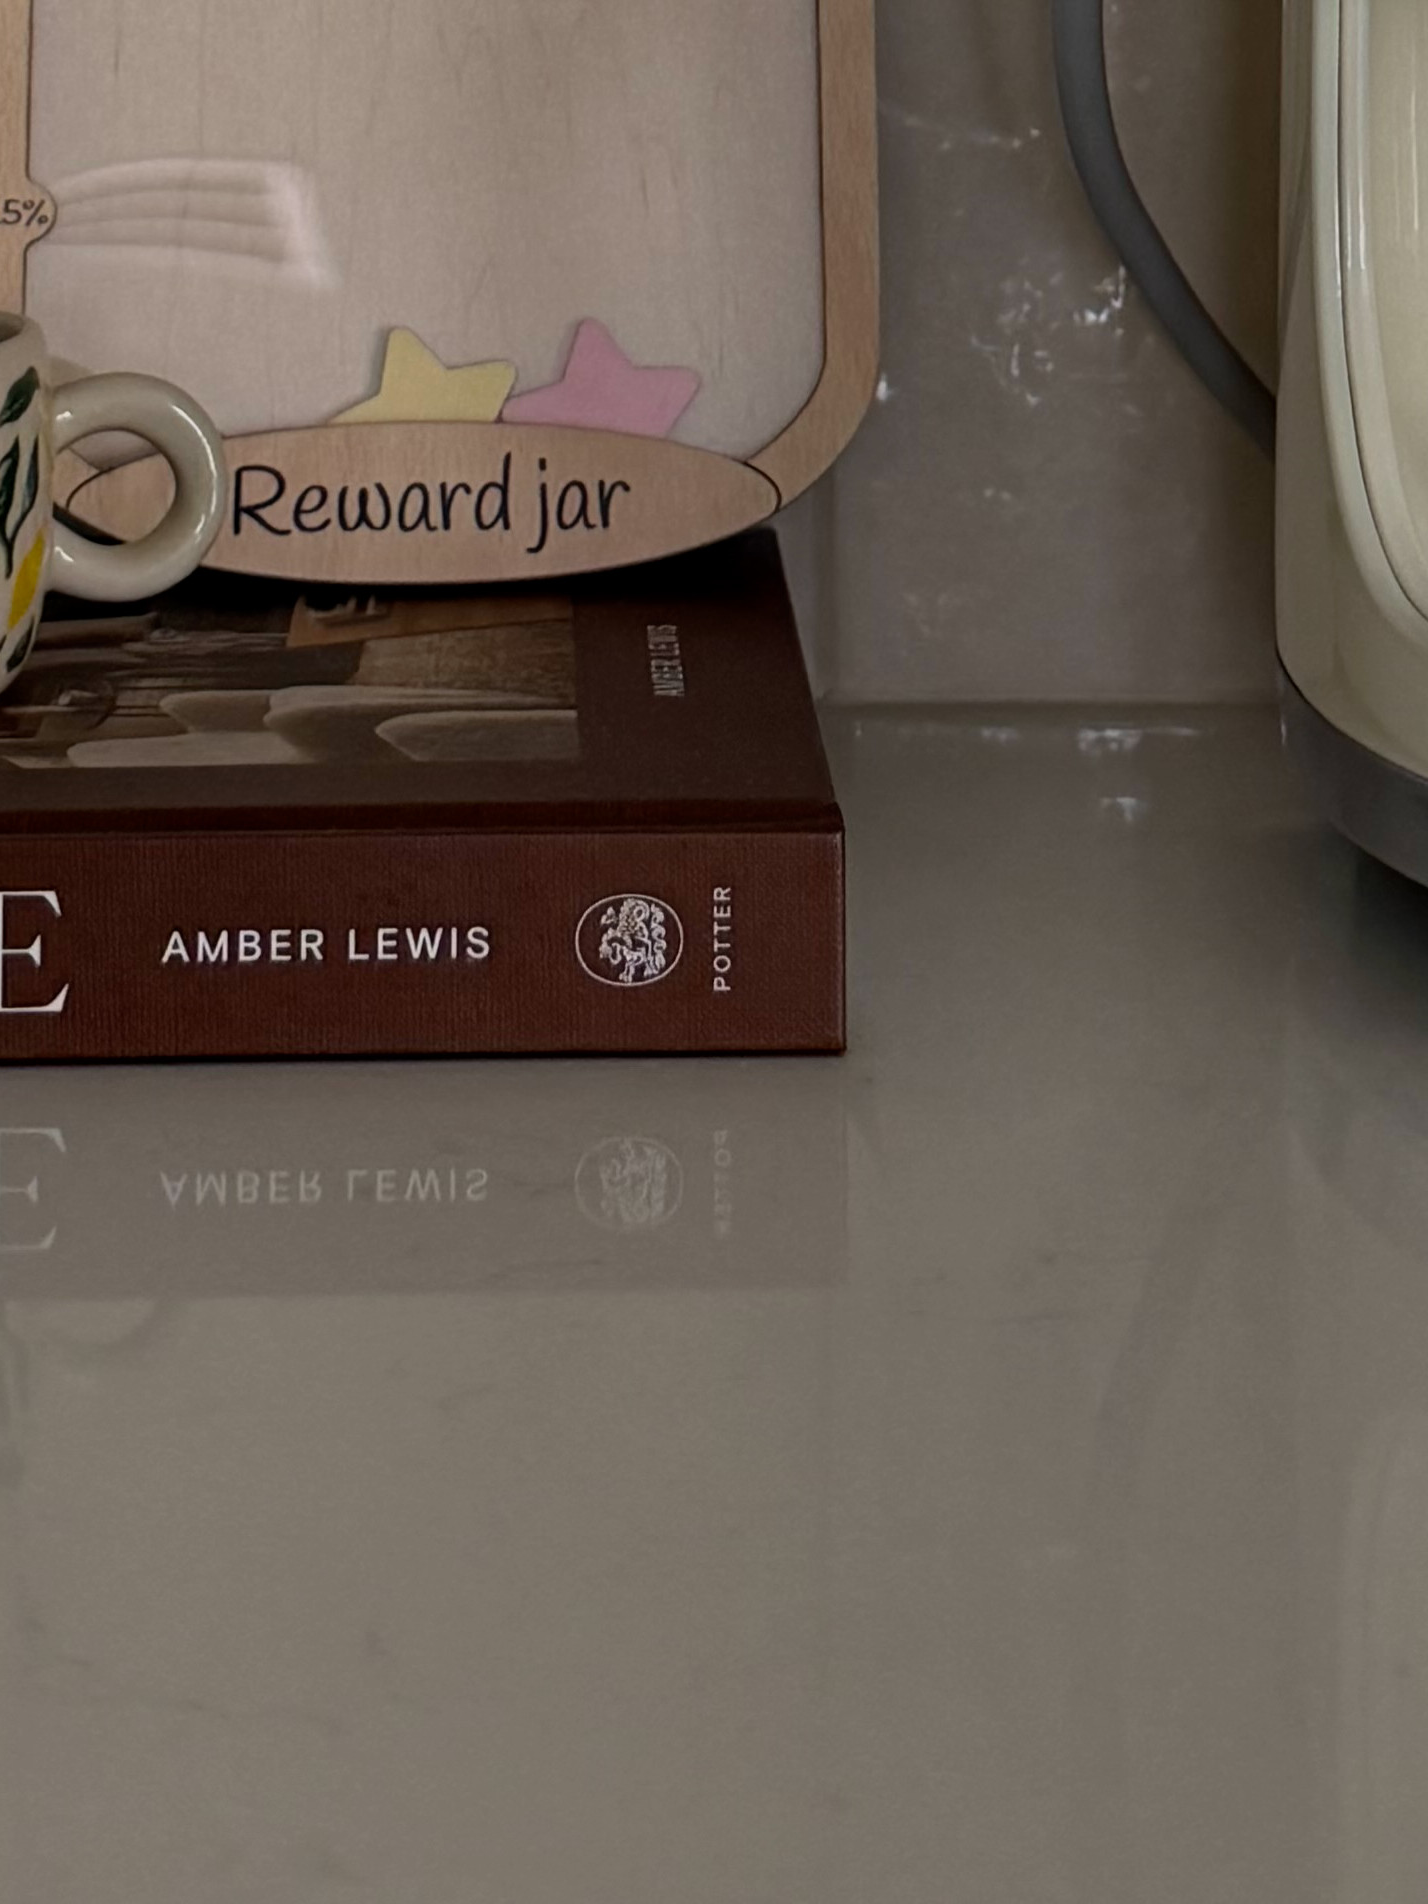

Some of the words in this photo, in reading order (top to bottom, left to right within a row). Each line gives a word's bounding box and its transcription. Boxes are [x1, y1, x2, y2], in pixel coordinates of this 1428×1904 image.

[232, 451, 512, 537] Reward
[525, 457, 632, 555] jar
[161, 928, 325, 964] AMBER
[348, 926, 492, 962] LEWIS
[713, 885, 732, 993] POTTER
